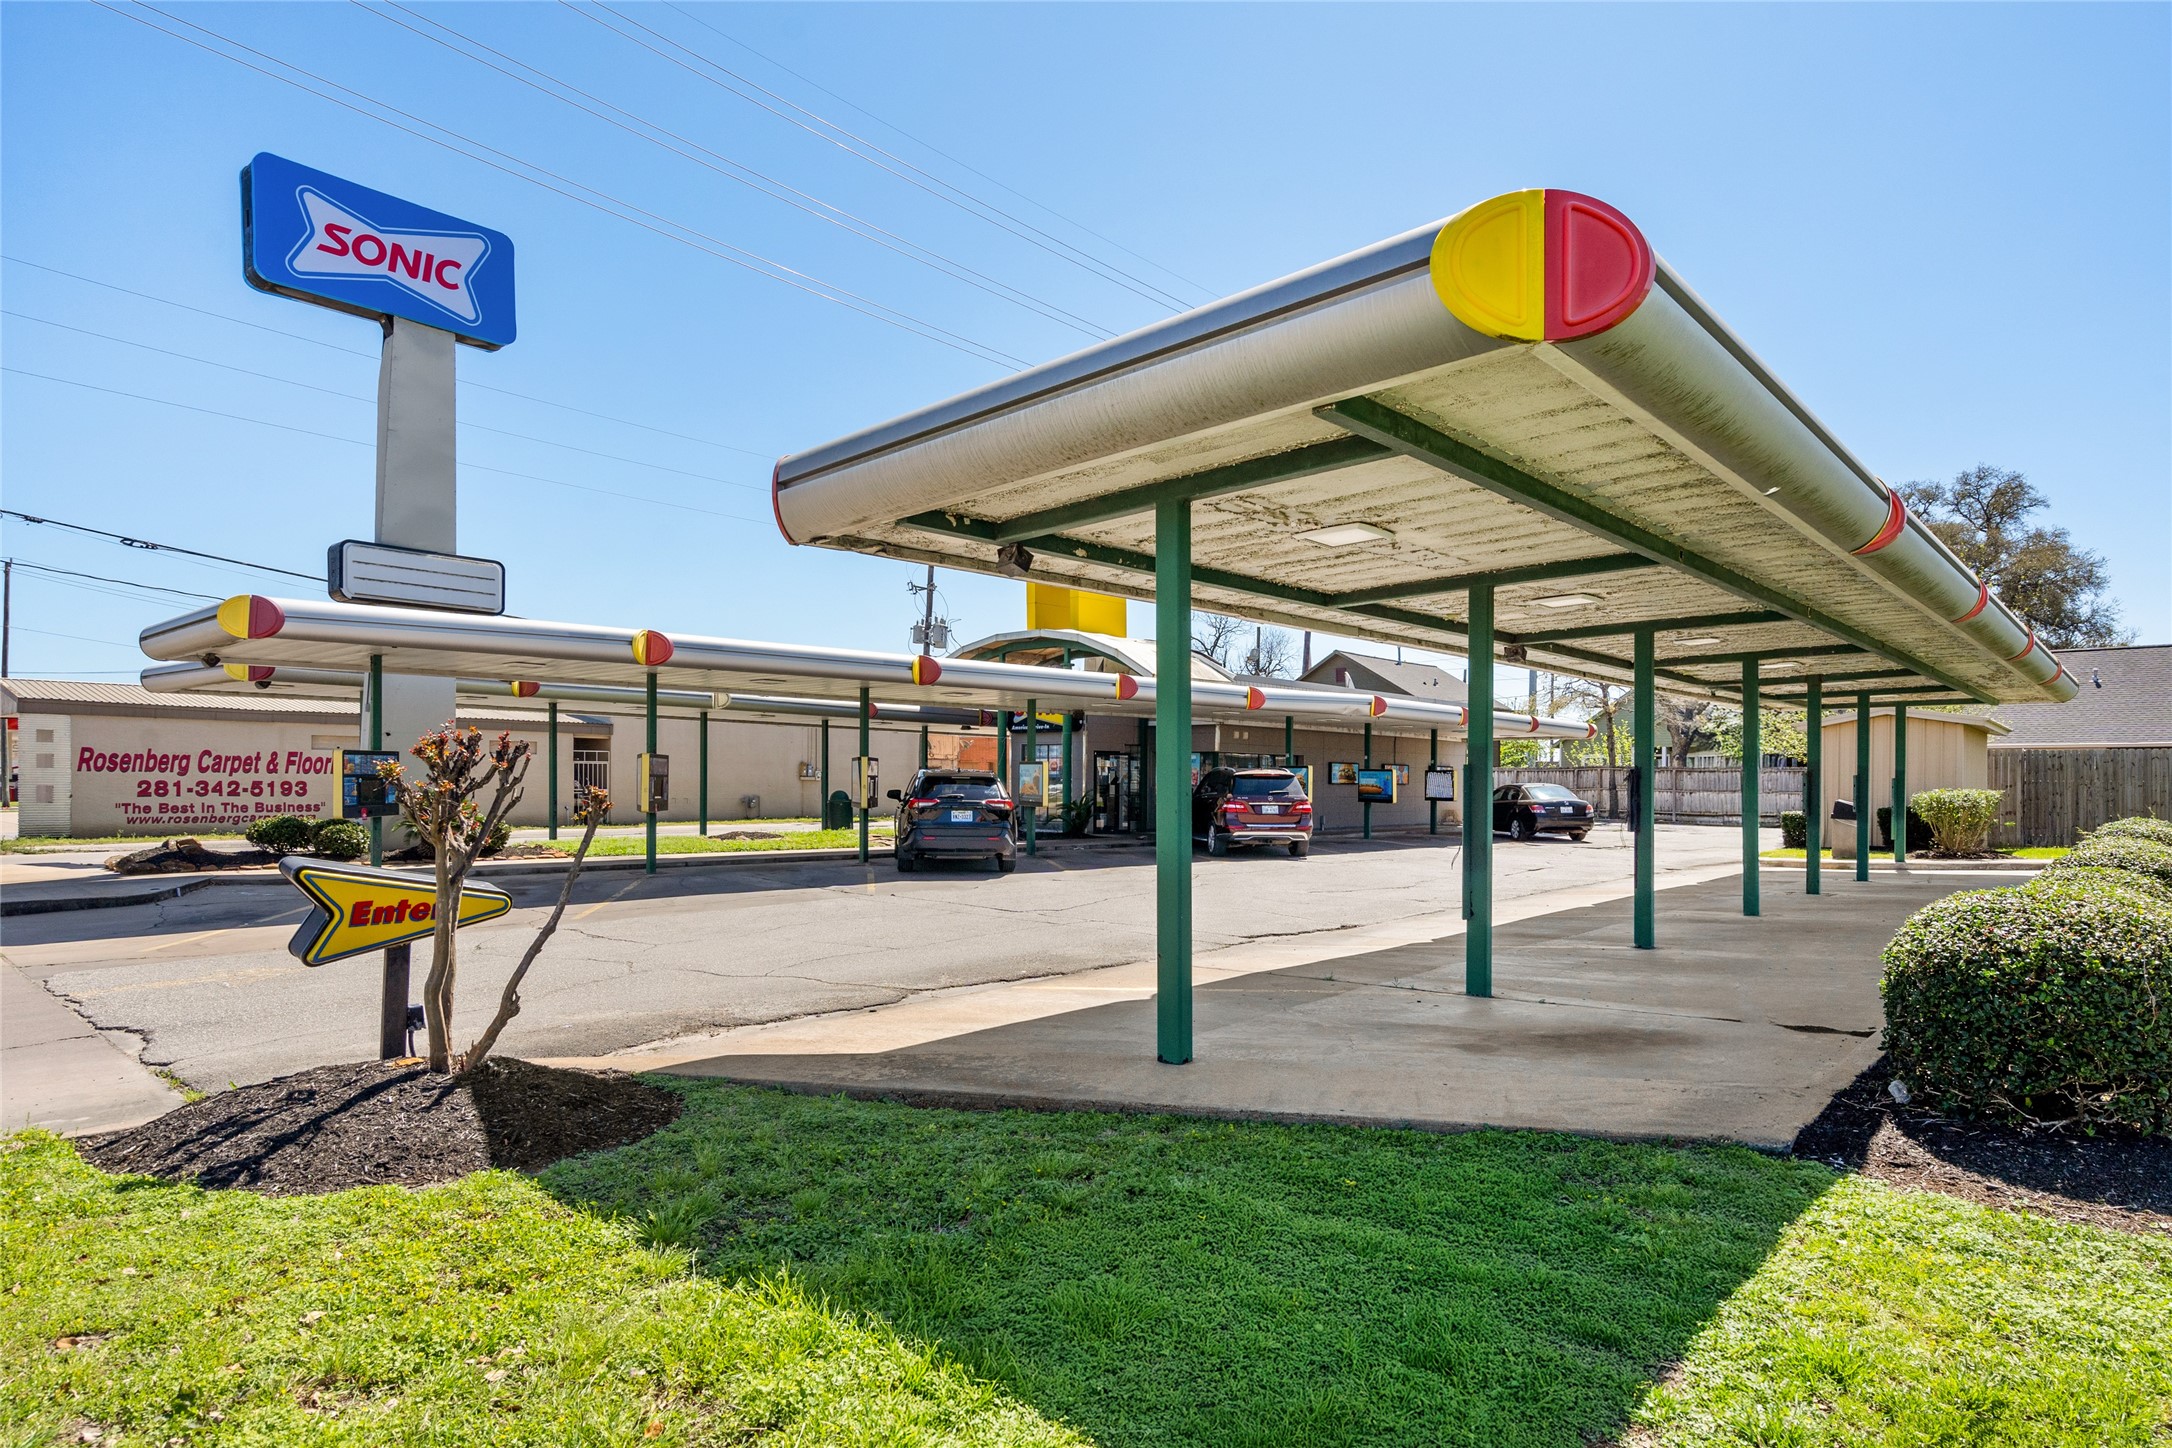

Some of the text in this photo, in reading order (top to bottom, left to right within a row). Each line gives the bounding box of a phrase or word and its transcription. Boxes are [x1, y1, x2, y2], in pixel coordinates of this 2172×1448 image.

[316, 223, 463, 290] SONIC
[77, 747, 191, 776] Rosenberg
[197, 749, 262, 777] Carpet
[265, 750, 279, 774] &
[136, 779, 308, 798] 281-342-5193
[158, 802, 195, 814] Best
[201, 802, 215, 814] In
[221, 802, 249, 814] The
